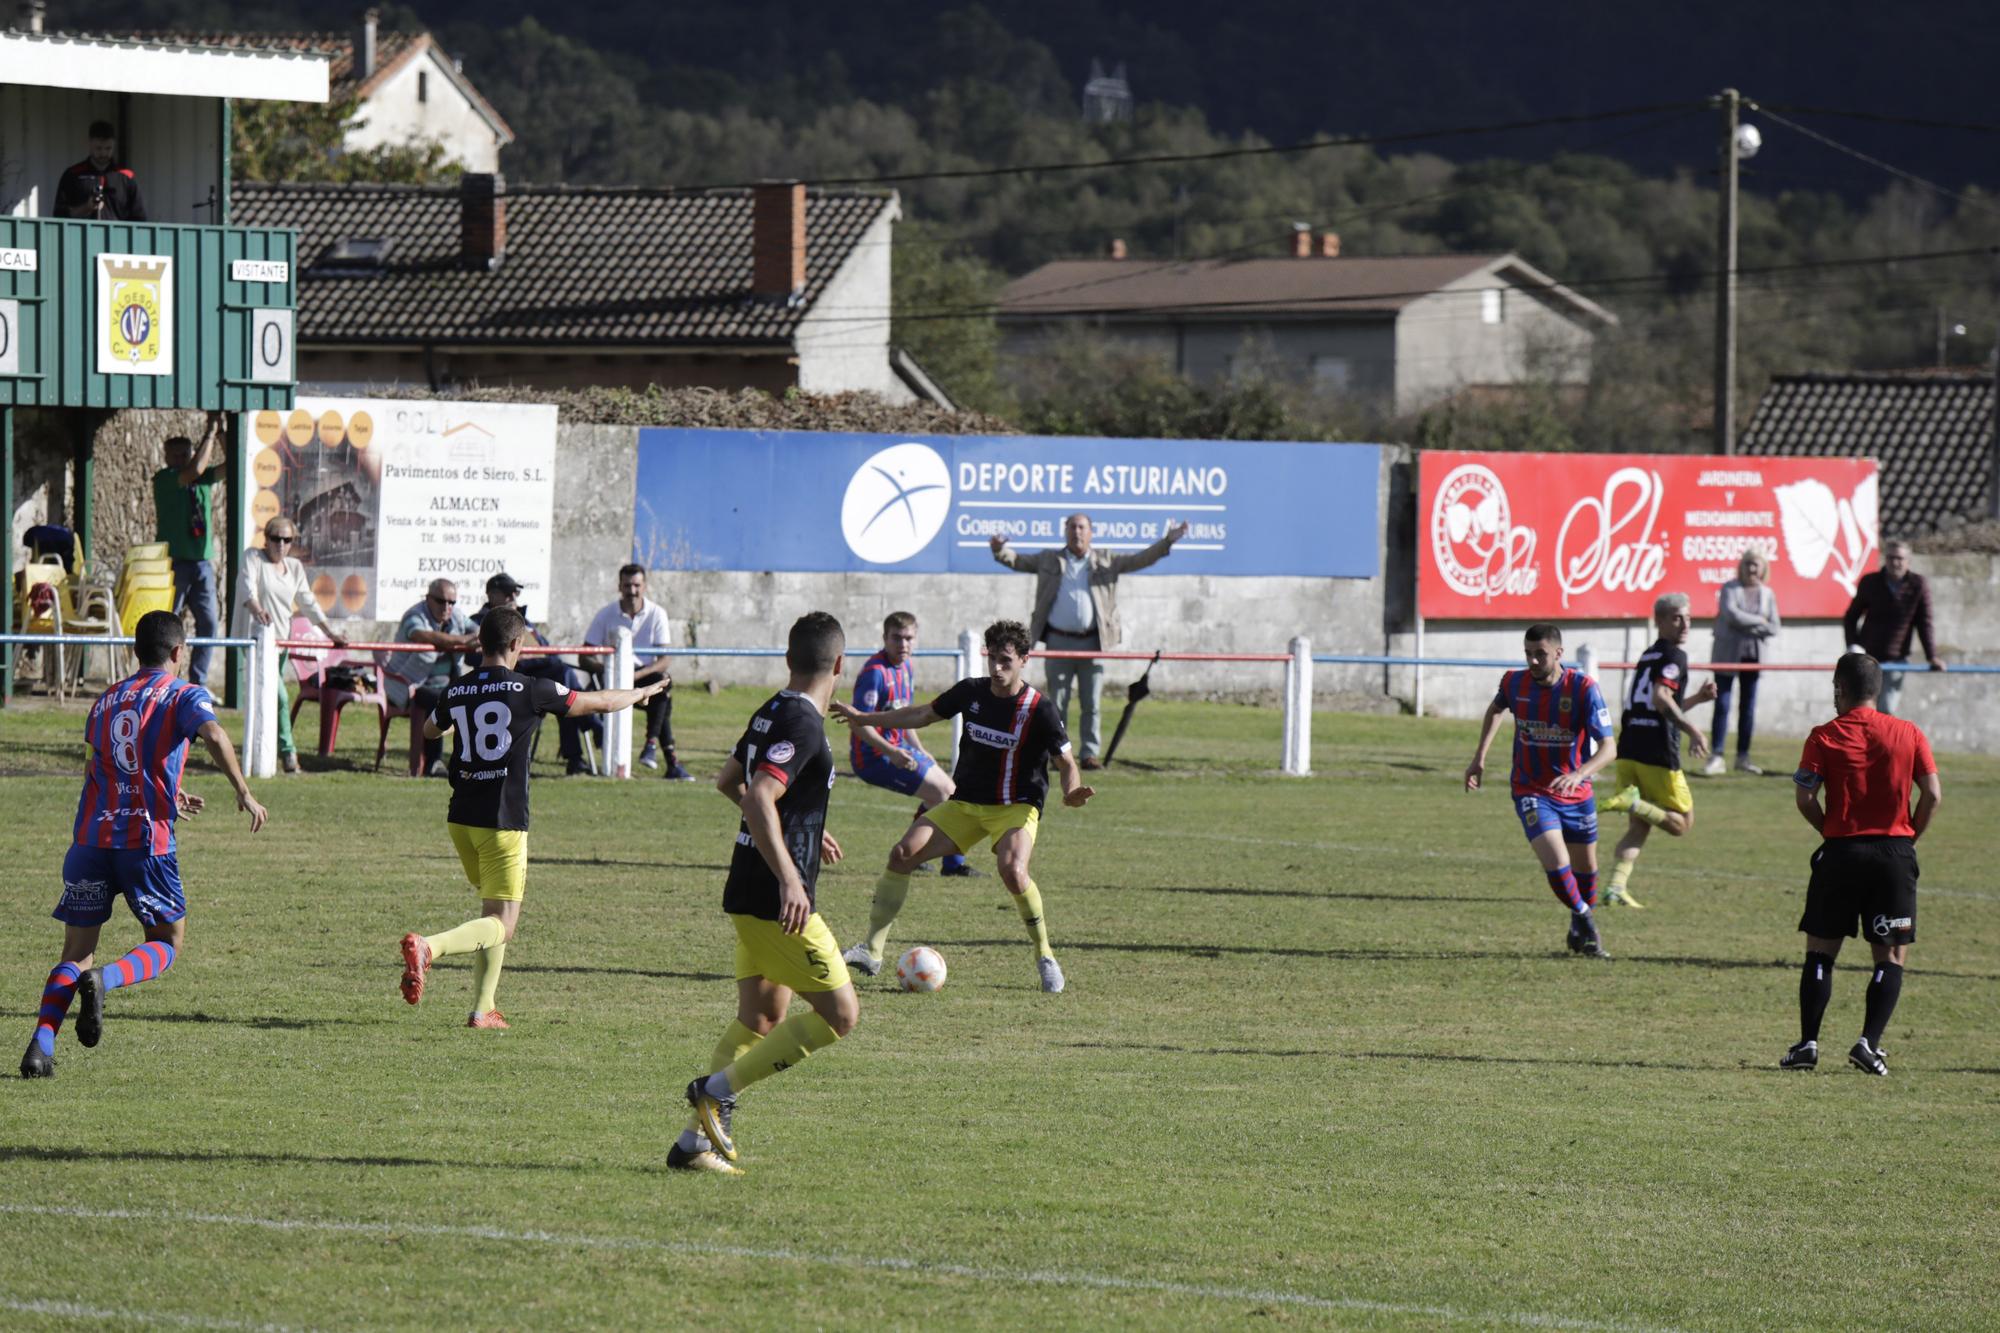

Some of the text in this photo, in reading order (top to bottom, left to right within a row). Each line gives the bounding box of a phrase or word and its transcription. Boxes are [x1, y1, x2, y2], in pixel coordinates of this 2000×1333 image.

[0, 252, 31, 267] CAL
[235, 263, 285, 279] VISITANTE
[262, 321, 282, 367] 0
[385, 464, 548, 482] Pavimentos de Siero, S.L.
[959, 462, 1228, 496] DEPORTE ASTURIANO
[429, 496, 500, 511] ALMACEN
[1724, 491, 1735, 506] Y
[386, 515, 412, 527] Venta
[415, 515, 426, 526] de
[429, 516, 438, 527] la
[441, 516, 469, 528] Salve,
[497, 518, 540, 529] Valdesoto
[478, 533, 491, 545] 44
[1555, 467, 1667, 609] Soto
[418, 557, 506, 572] EXPOSICION
[447, 681, 524, 699] BORJA PRIETO
[450, 701, 513, 762] 18
[110, 709, 141, 775] 8
[115, 782, 140, 795] Vica
[805, 949, 830, 979] 5
